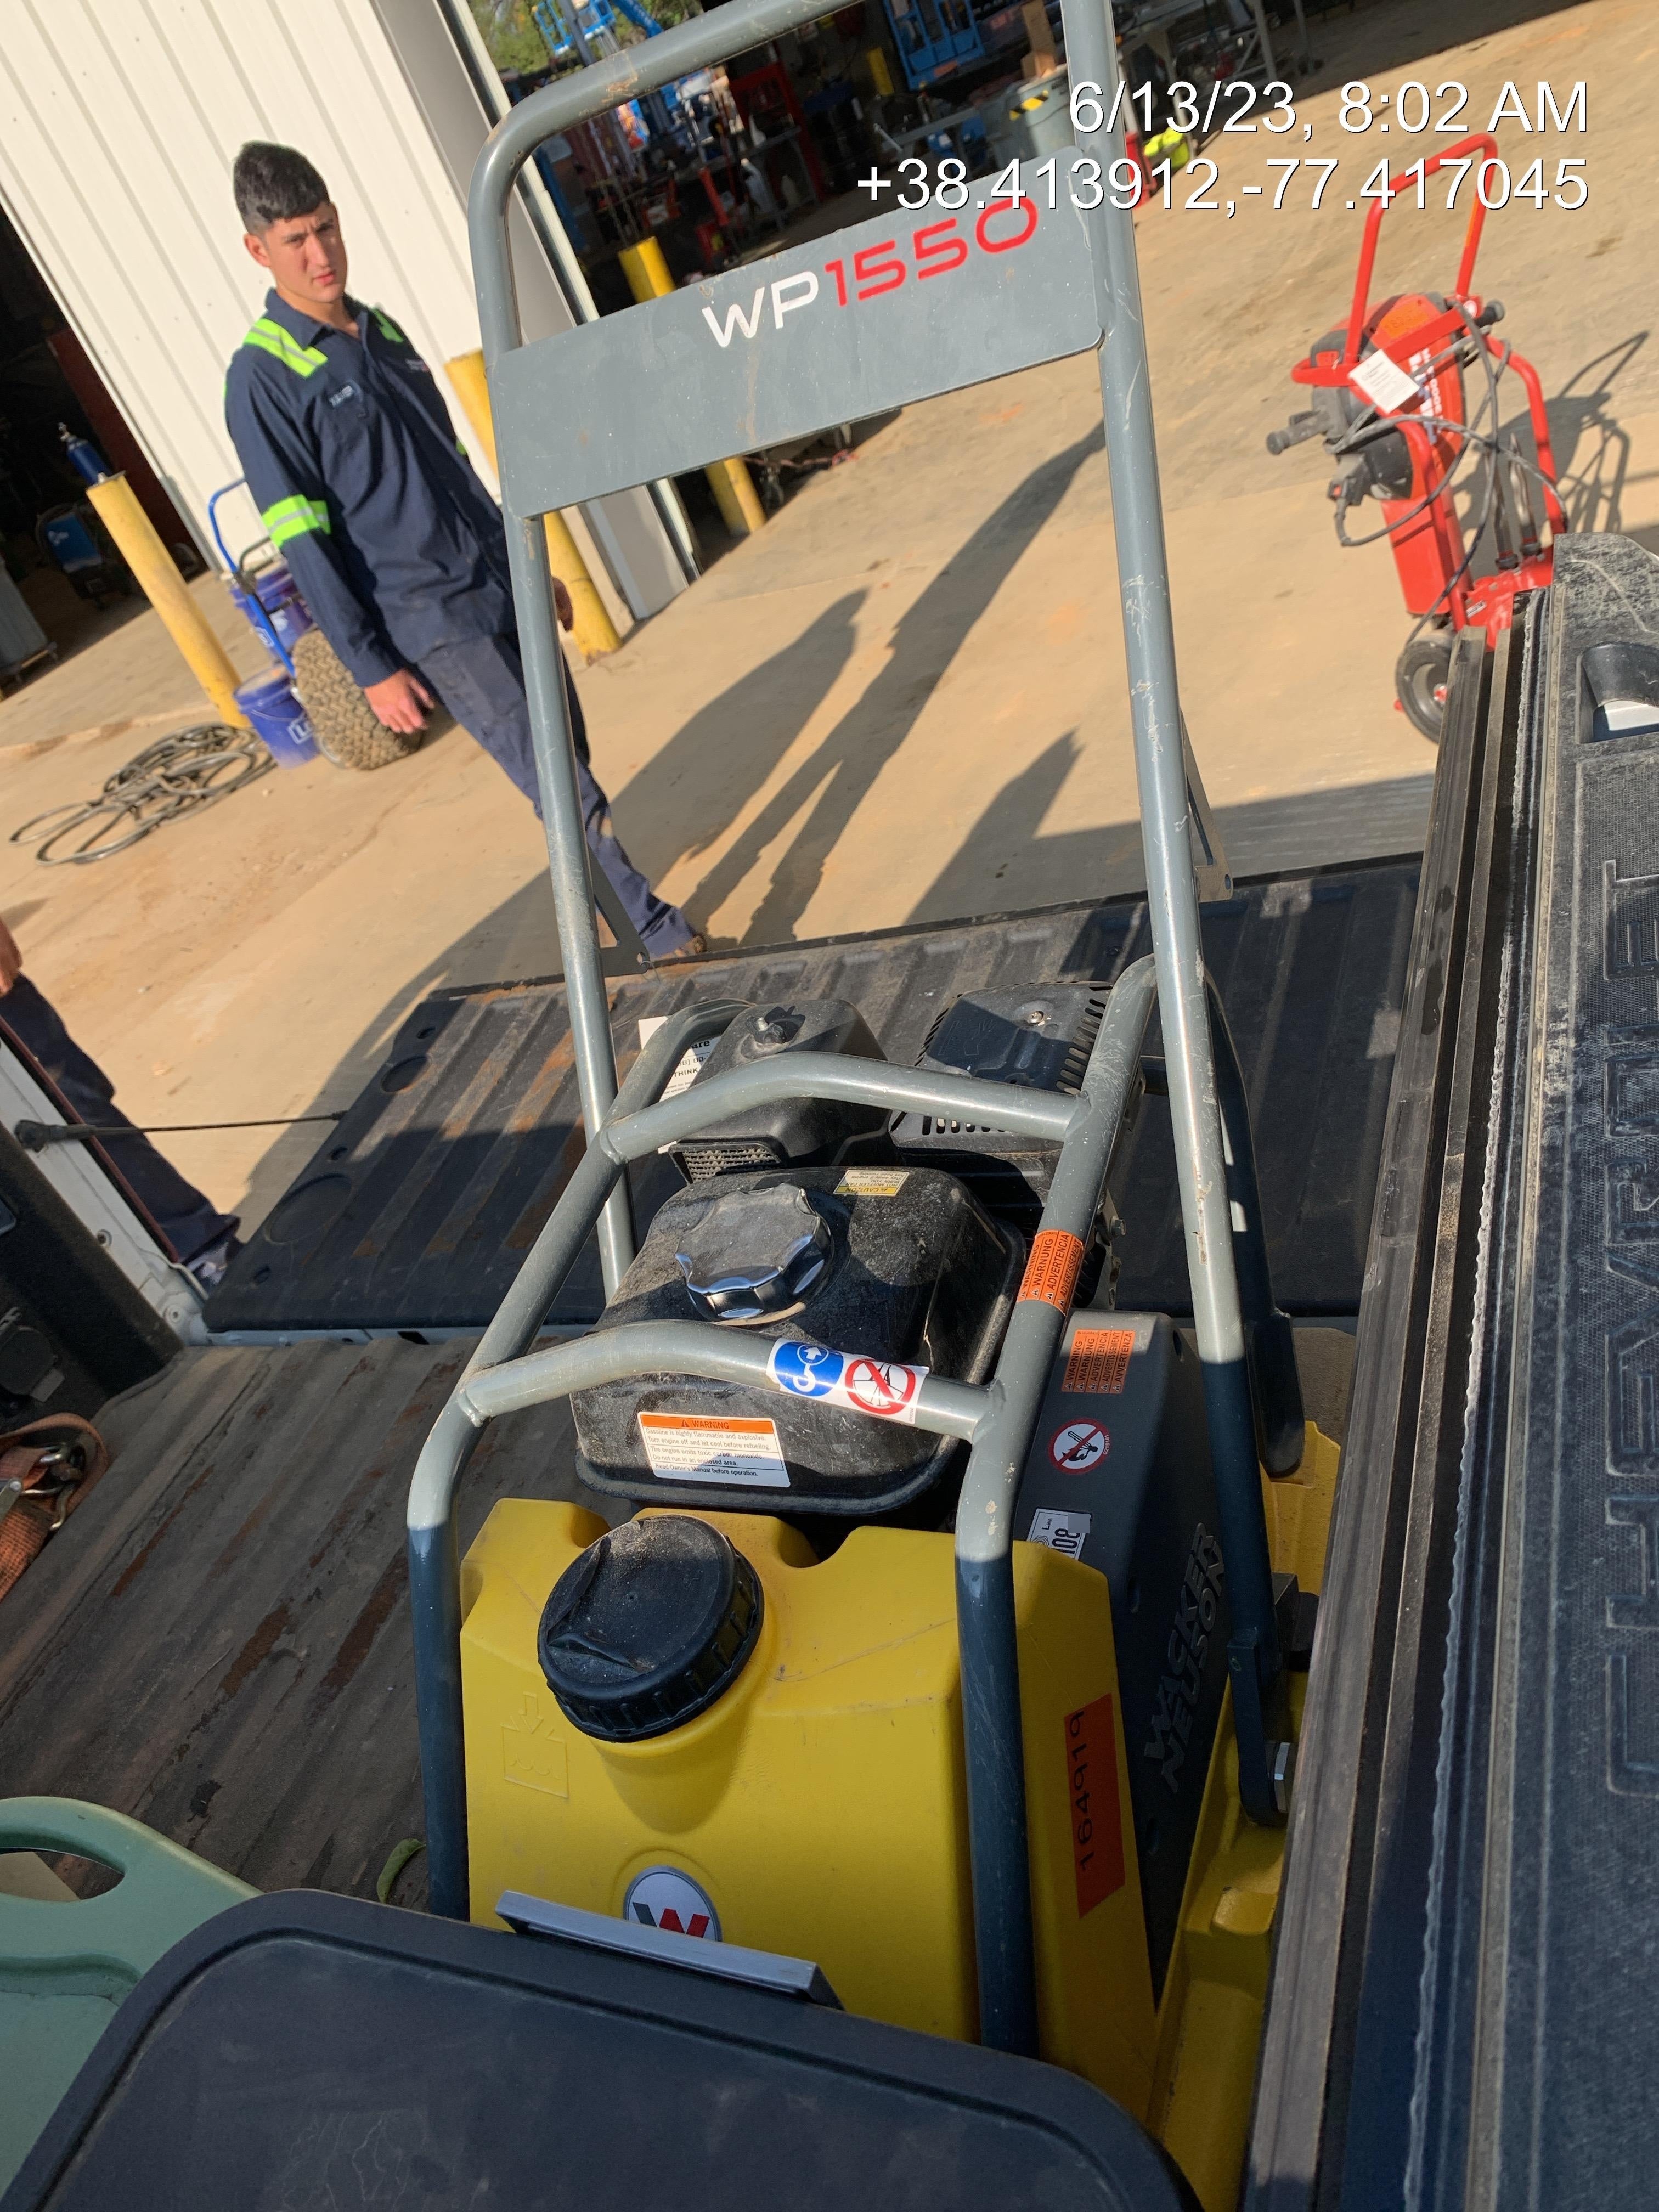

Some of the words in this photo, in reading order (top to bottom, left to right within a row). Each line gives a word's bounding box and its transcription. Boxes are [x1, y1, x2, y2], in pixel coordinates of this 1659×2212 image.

[701, 195, 1039, 348] WP1550
[674, 1067, 698, 1077] THINK
[1023, 1244, 1040, 1288] WARNING
[1032, 1238, 1053, 1286] WARNUNG
[1047, 1234, 1070, 1291] ADVERTENCIA
[1059, 1238, 1081, 1297] ADVERTISSEMENT
[1066, 1341, 1082, 1381] WARNING
[1078, 1338, 1095, 1381] WARNUNG
[1090, 1332, 1109, 1381] ADVERTENCIA
[1102, 1331, 1121, 1382] ADVERTISSEMENT
[1114, 1332, 1133, 1383] AVVERTENZA
[691, 1420, 730, 1430] WARNING
[1144, 1522, 1214, 1759] WACKER
[1161, 1536, 1225, 1794] NEUSON
[1069, 1710, 1095, 1871] 164919
